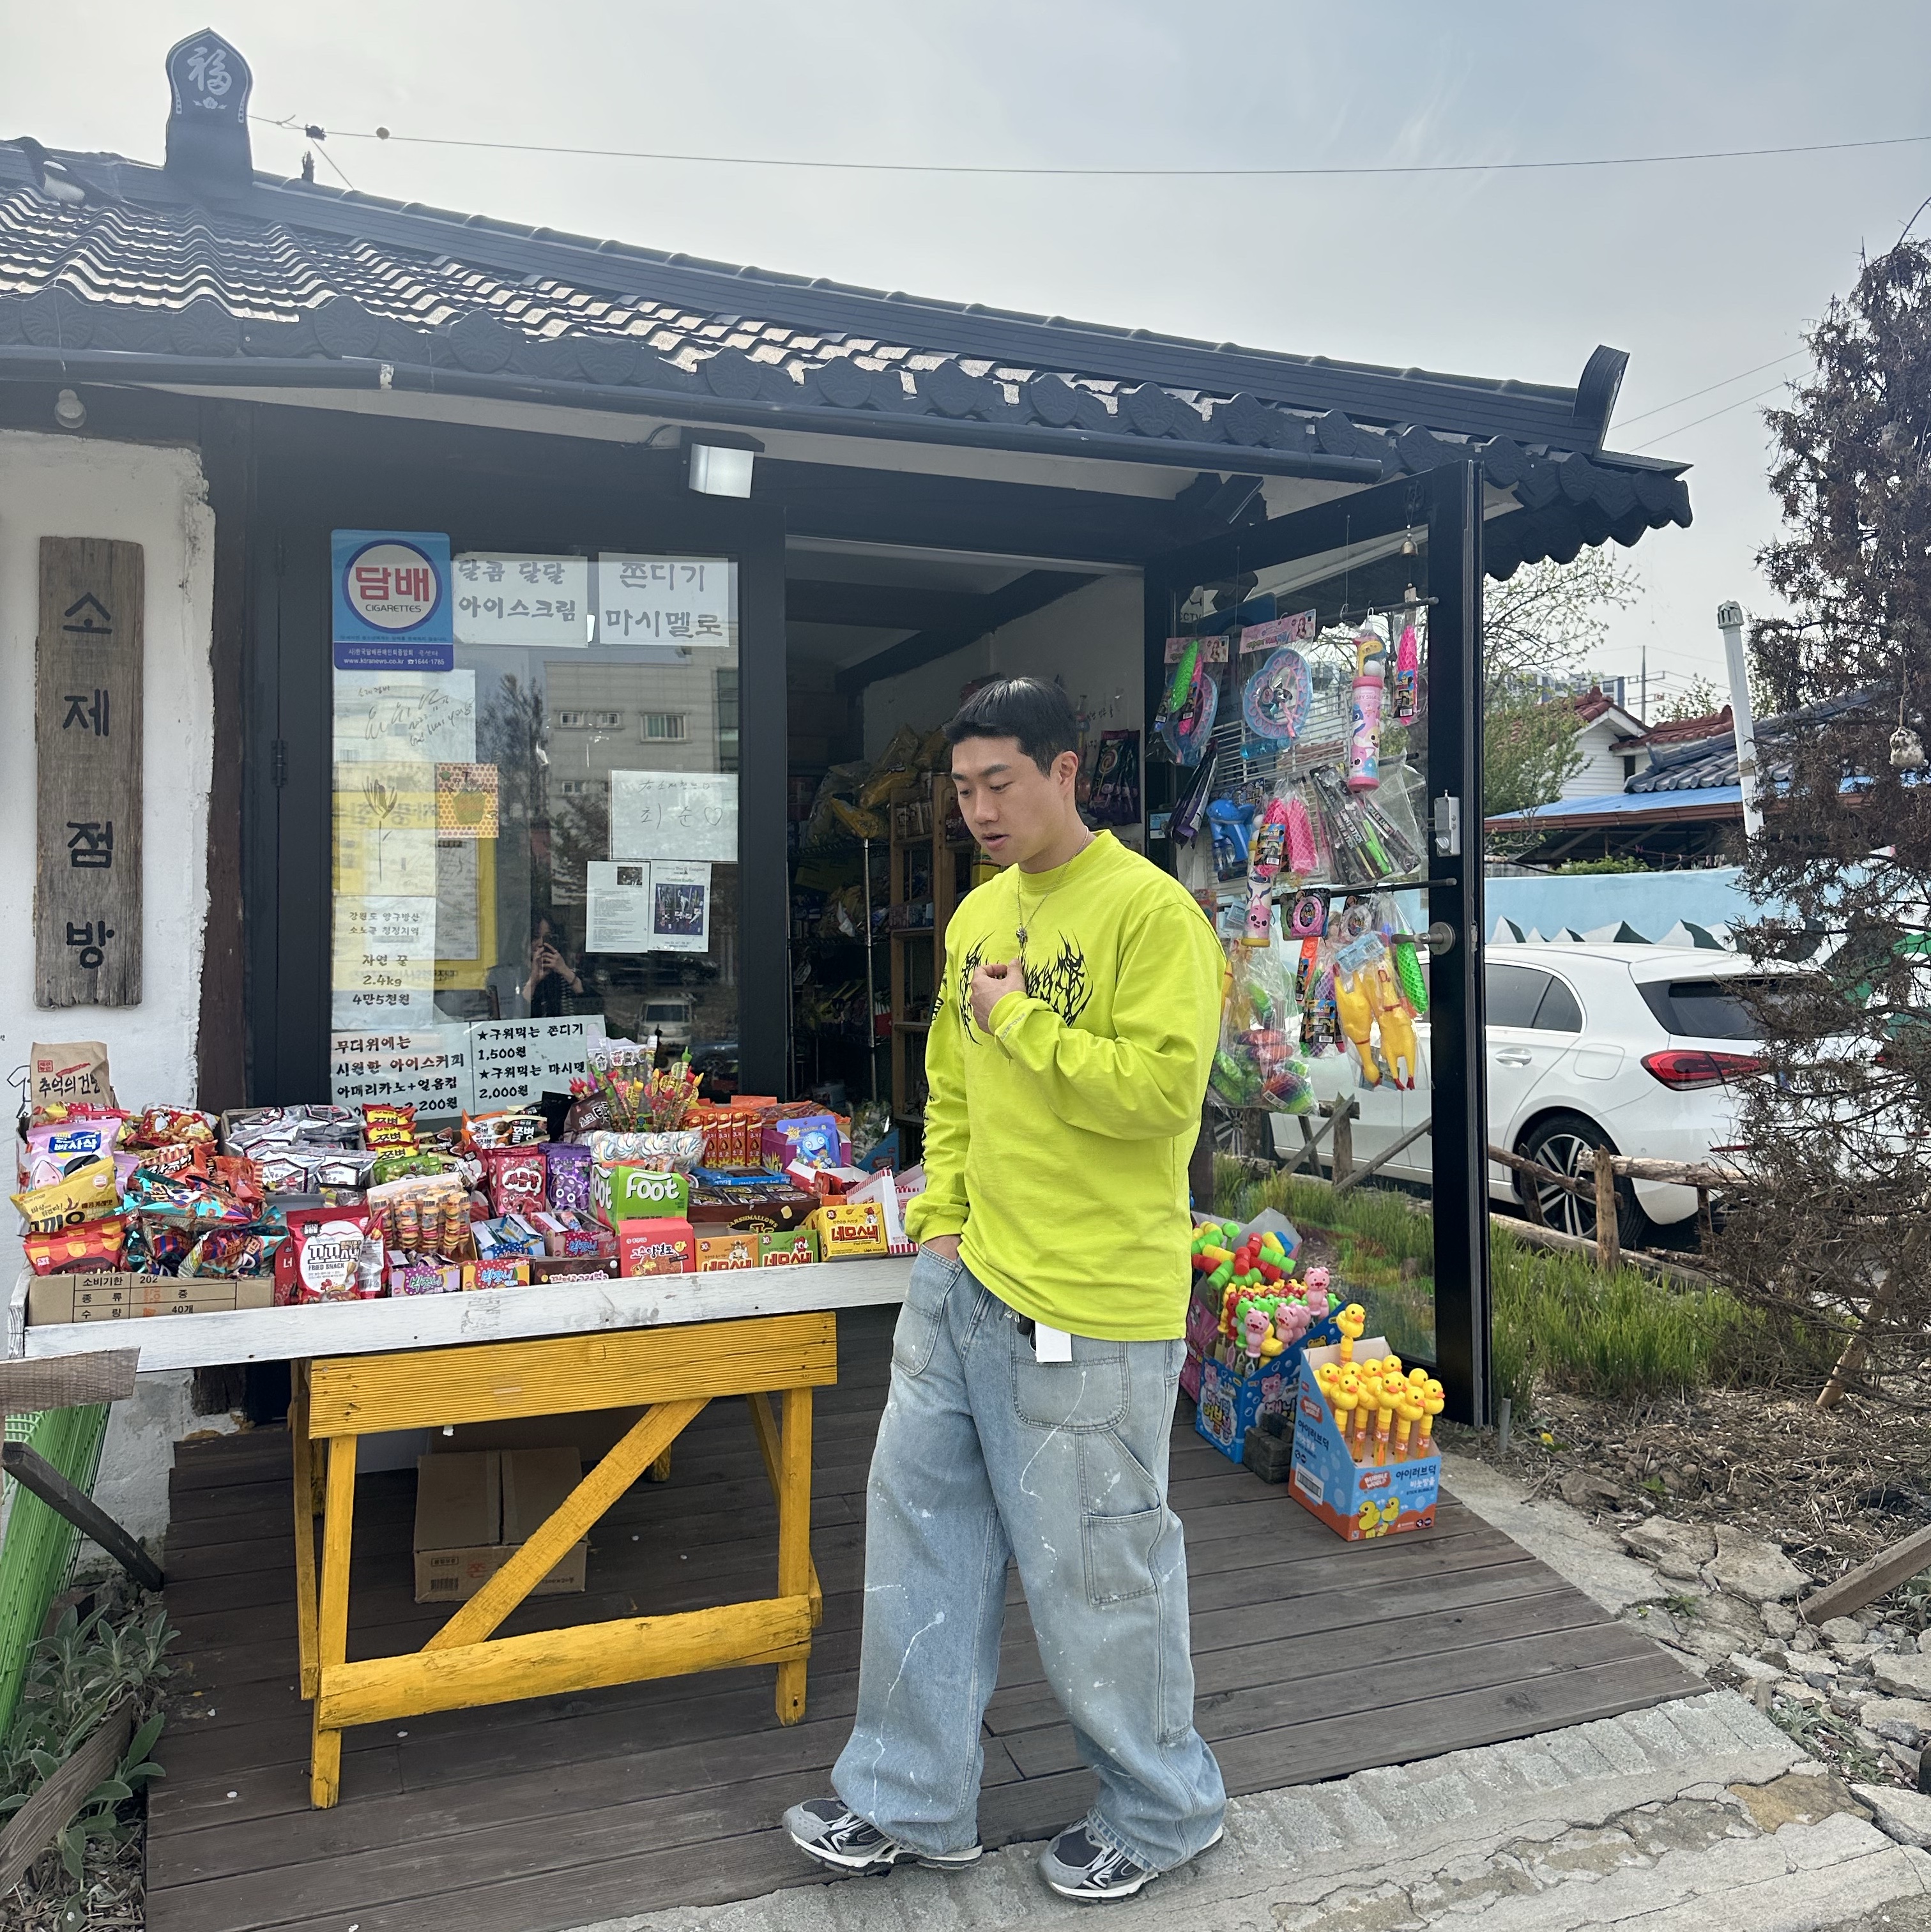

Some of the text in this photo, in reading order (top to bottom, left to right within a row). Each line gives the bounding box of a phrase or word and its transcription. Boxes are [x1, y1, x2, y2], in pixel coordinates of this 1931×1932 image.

[459, 560, 565, 585] 달콤 달달
[620, 562, 705, 592] 쫀디기
[356, 567, 429, 602] 담배
[365, 604, 422, 613] CIGARETTES
[459, 597, 576, 622] 아이스크림
[606, 609, 723, 638] 마시멜로
[63, 592, 115, 969] 소제점방
[349, 912, 378, 921] 강원도
[383, 926, 419, 936] 청정지역
[362, 954, 408, 966] 자연 꿀
[363, 975, 402, 987] 2.4kg
[353, 994, 409, 1005] 4만5천원
[547, 1023, 584, 1037] 쫀디기
[335, 1035, 411, 1053] 무더위에는
[478, 1046, 526, 1061] 1,500원
[336, 1053, 464, 1077] 시원한 아이스커피
[39, 1076, 75, 1099] 추억의
[478, 1084, 528, 1099] 2,000원
[626, 1172, 680, 1201] Foot
[831, 1225, 879, 1242] 네모스낵
[82, 1276, 123, 1286] 소비기한
[112, 1292, 122, 1302] 류
[81, 1304, 193, 1319] 수 량 40개
[1298, 1420, 1329, 1451] 아이러브덕
[1396, 1464, 1437, 1480] 아이러브덕
